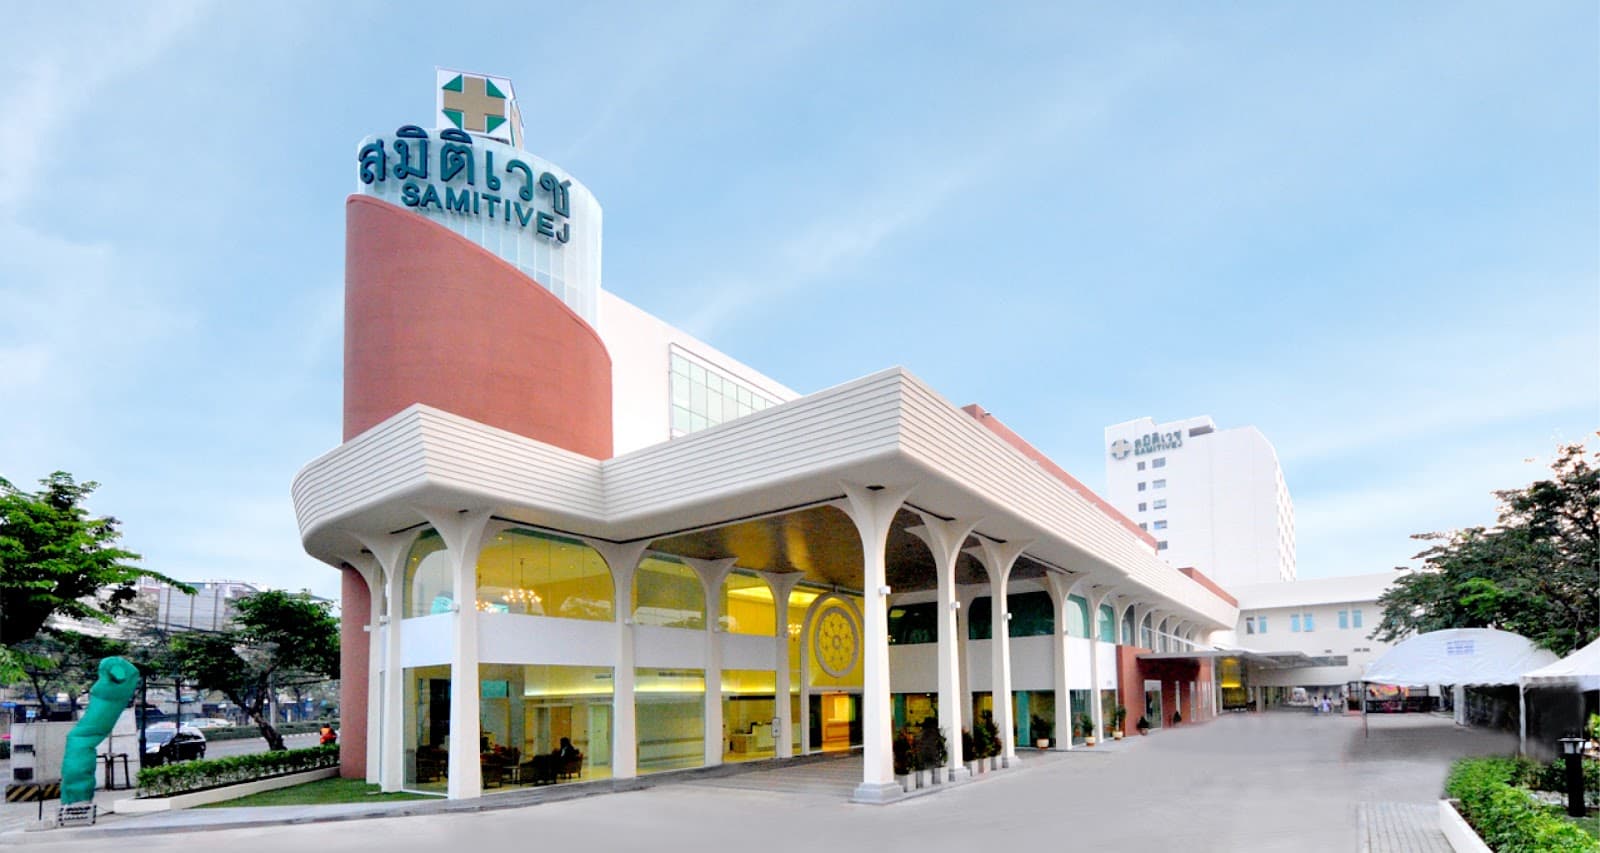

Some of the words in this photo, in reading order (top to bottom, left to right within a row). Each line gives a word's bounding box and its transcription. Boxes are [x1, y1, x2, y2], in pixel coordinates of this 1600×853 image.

[359, 125, 572, 218] สมิติเวช
[401, 181, 570, 244] SAMITIVEJ
